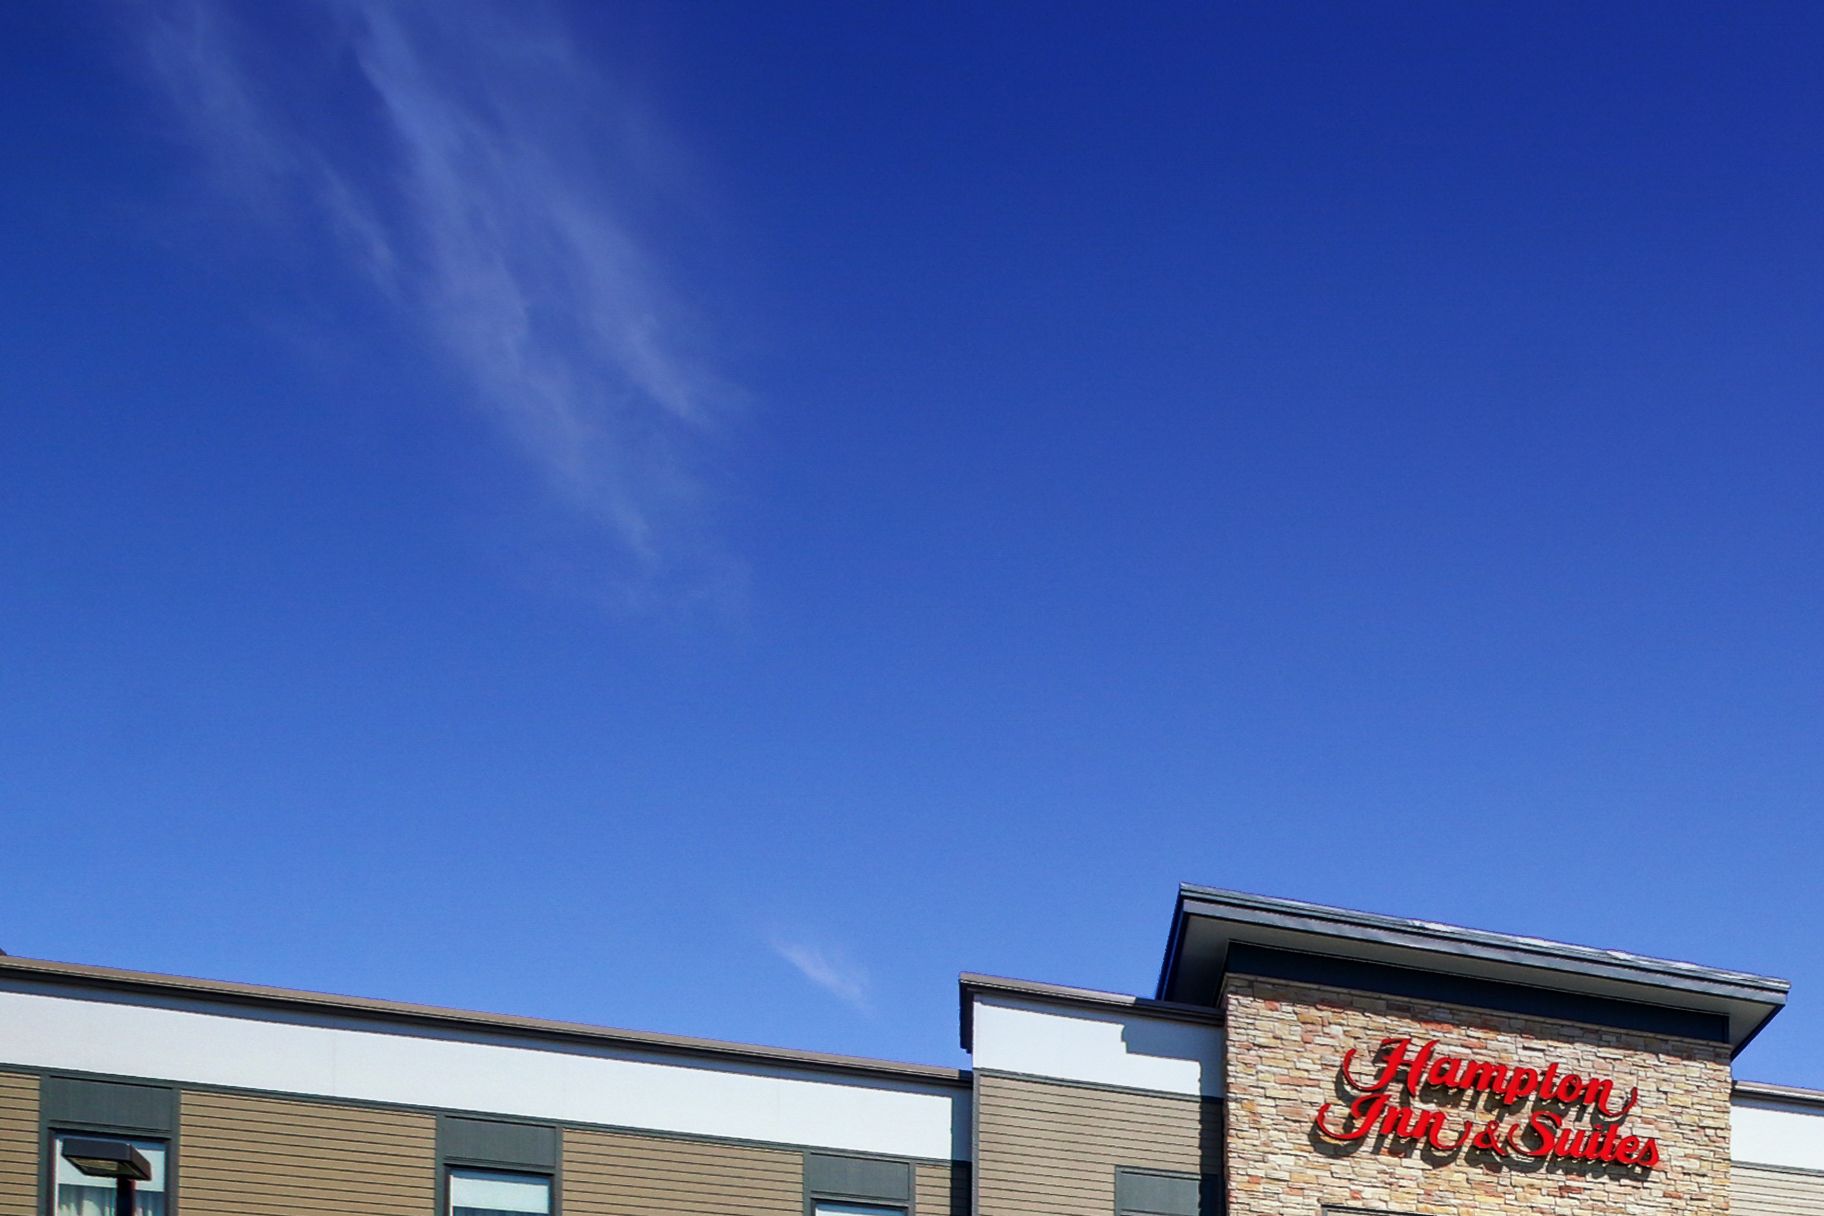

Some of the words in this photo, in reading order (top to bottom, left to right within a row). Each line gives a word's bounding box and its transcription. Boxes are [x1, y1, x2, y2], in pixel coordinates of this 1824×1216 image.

[1341, 1038, 1638, 1117] Hampton
[1315, 1093, 1472, 1150] Inn
[1472, 1121, 1507, 1156] &
[1508, 1111, 1660, 1167] Suites
